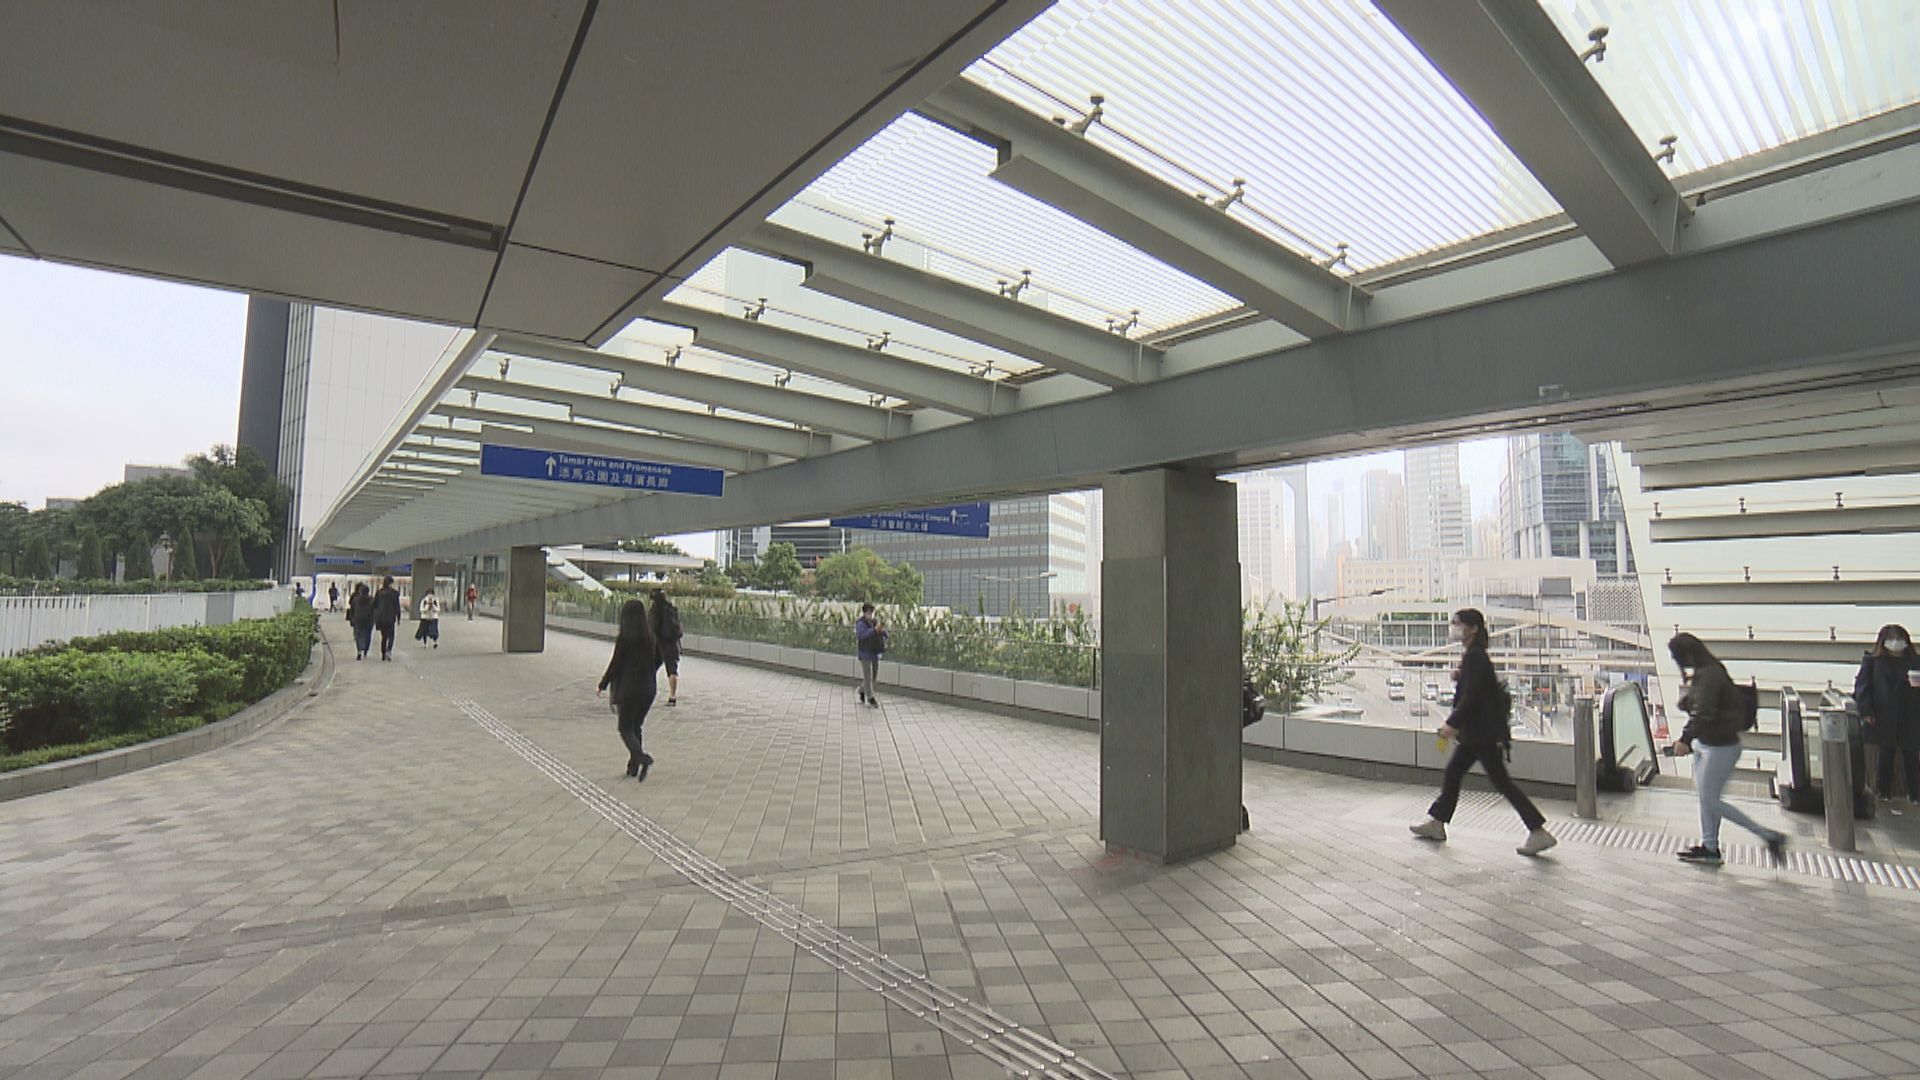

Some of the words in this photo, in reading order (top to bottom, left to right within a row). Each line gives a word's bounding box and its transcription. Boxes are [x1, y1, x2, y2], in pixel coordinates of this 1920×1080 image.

[558, 454, 585, 466] Tamar
[587, 458, 607, 468] Park
[609, 461, 625, 470] and
[626, 462, 672, 475] Promenade
